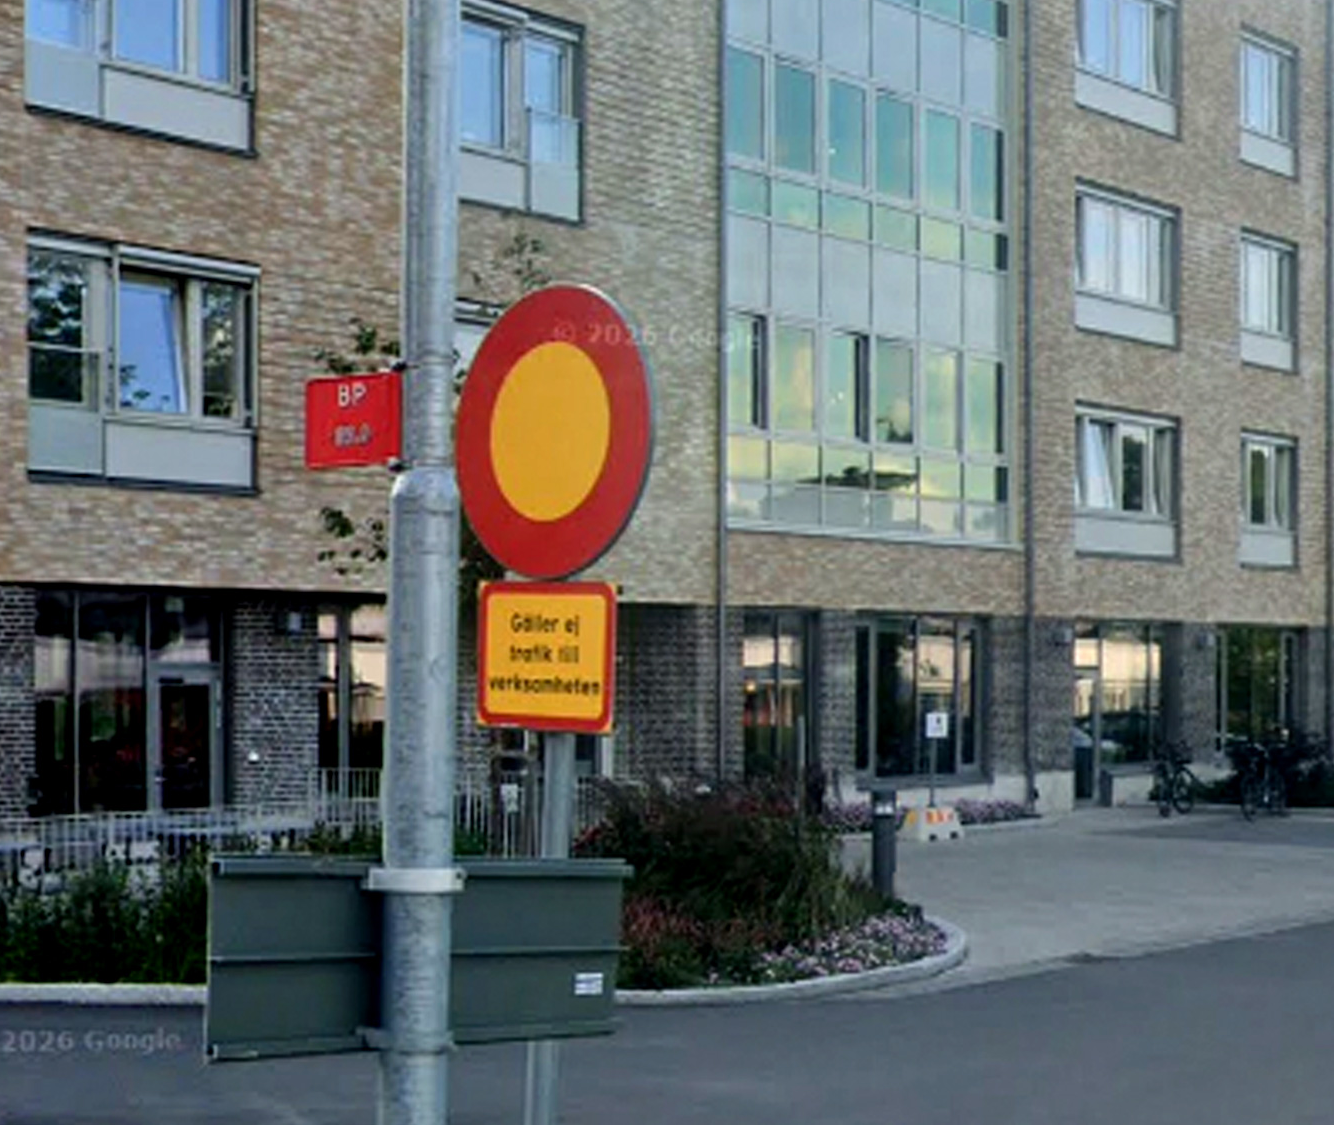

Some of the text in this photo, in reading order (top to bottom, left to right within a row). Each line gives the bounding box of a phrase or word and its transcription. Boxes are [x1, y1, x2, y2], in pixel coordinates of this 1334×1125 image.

[337, 382, 366, 407] BP
[565, 614, 580, 637] ej
[509, 644, 580, 664] trafik till
[489, 675, 600, 695] verksamheten
